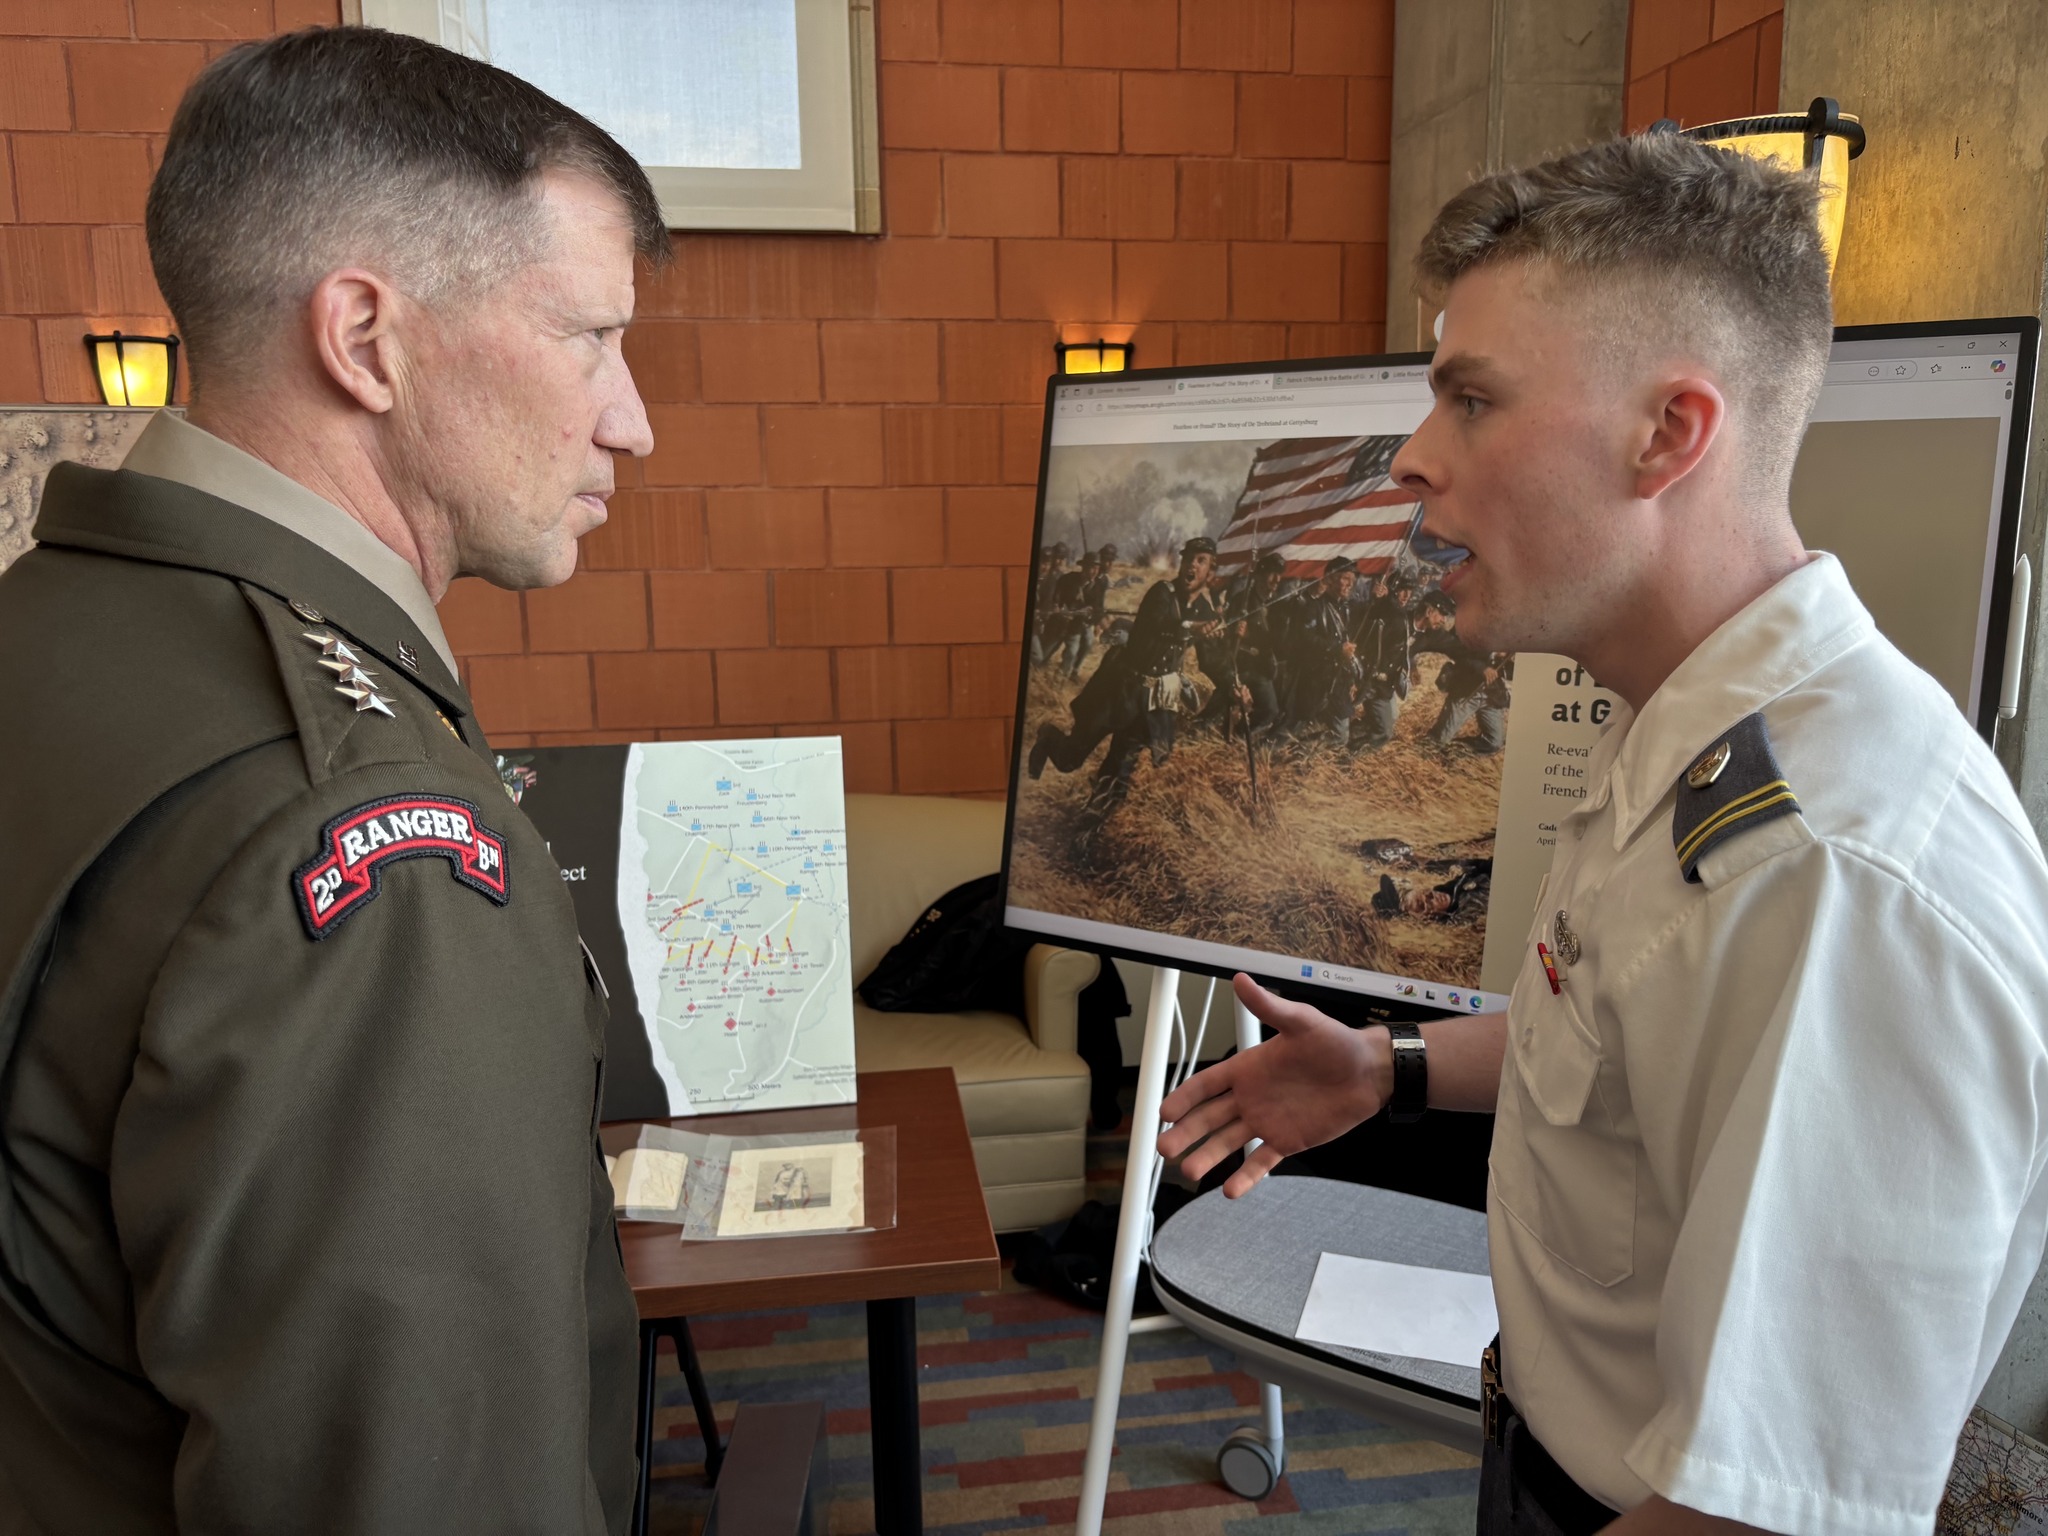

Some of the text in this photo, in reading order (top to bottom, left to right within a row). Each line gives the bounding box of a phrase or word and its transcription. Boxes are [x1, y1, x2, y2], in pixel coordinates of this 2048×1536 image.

[1551, 700, 1581, 723] at
[1547, 743, 1593, 758] Re-eva
[1544, 764, 1584, 778] of the
[1543, 783, 1587, 799] French
[340, 808, 473, 866] RANGER
[478, 839, 500, 871] BN
[1536, 836, 1556, 846] April
